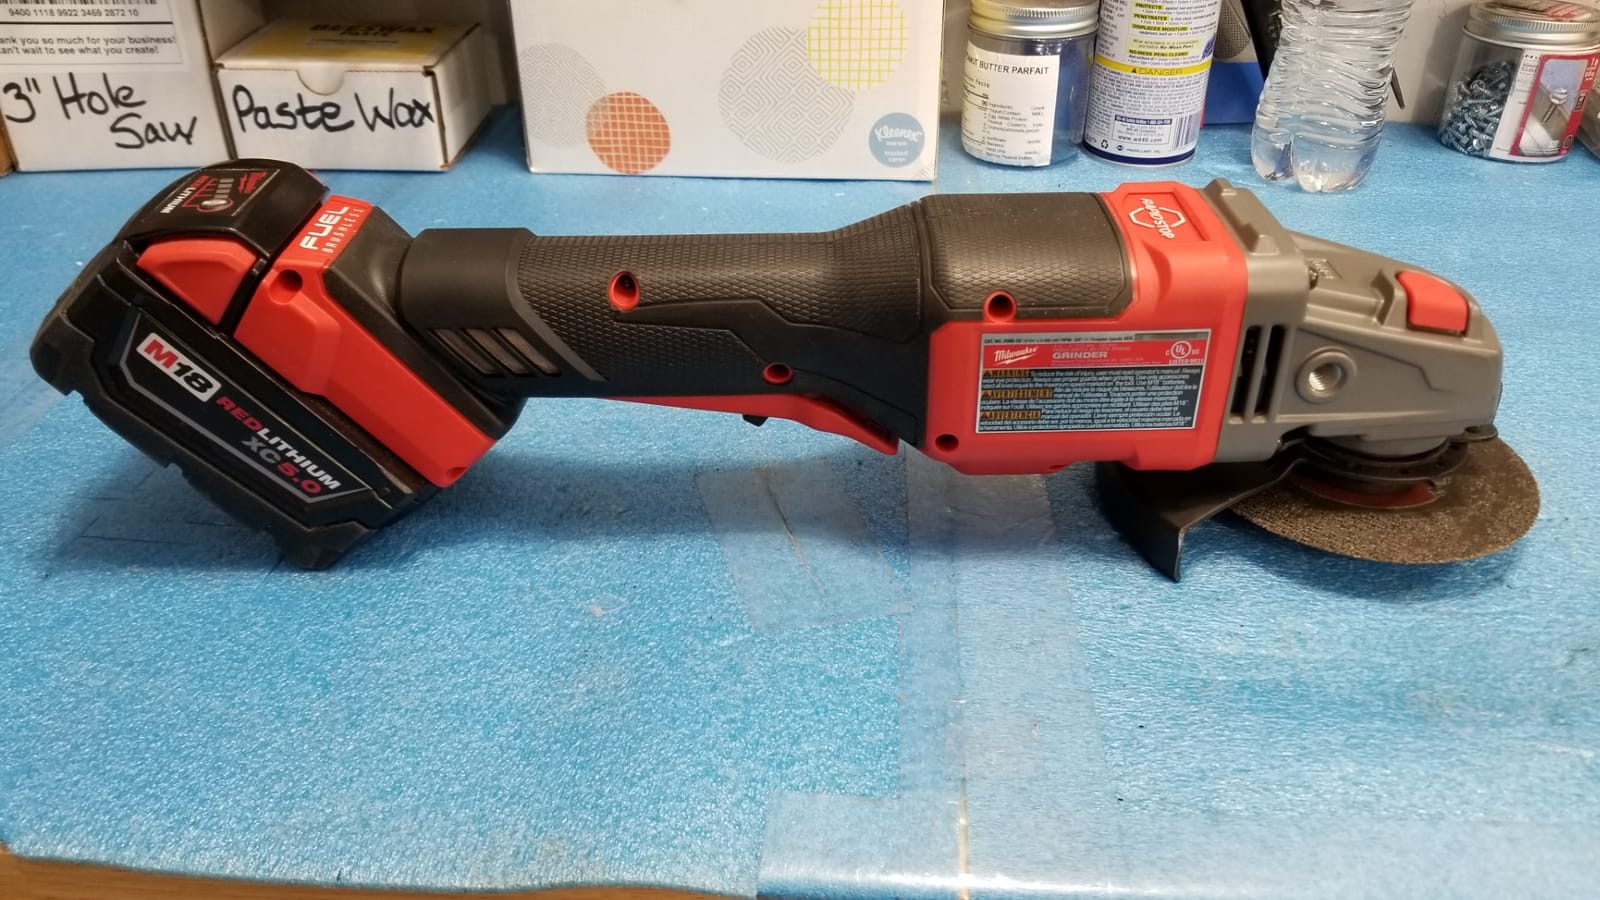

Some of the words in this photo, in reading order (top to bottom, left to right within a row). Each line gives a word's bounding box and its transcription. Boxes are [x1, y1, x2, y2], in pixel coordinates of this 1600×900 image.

[8, 8, 31, 16] 9400
[57, 8, 78, 16] 9922
[104, 8, 127, 16] 2872
[128, 8, 140, 16] 10
[1132, 24, 1161, 32] DISPLACES
[0, 36, 18, 44] ank
[20, 38, 39, 46] you
[56, 36, 84, 44] much
[86, 36, 100, 44] for
[104, 38, 126, 46] your
[0, 46, 20, 54] an't
[22, 46, 43, 54] wait
[45, 46, 56, 54] to
[78, 46, 102, 54] what
[104, 48, 123, 56] you
[125, 46, 159, 54] create!
[979, 60, 1010, 74] BUTTER
[1012, 66, 1048, 74] PARFAIT
[1139, 68, 1184, 76] DANGER
[3, 77, 41, 123] 3"
[53, 72, 146, 120] Hole
[232, 85, 354, 133] Paste
[354, 87, 435, 132] Wax
[110, 112, 198, 149] Saw
[874, 124, 922, 142] Kleenex
[299, 206, 350, 251] FUEL
[322, 207, 365, 254] BRUSHLESS
[994, 346, 1040, 362] Milwaukee
[1052, 352, 1108, 360] GRINDER
[143, 338, 214, 395] M18
